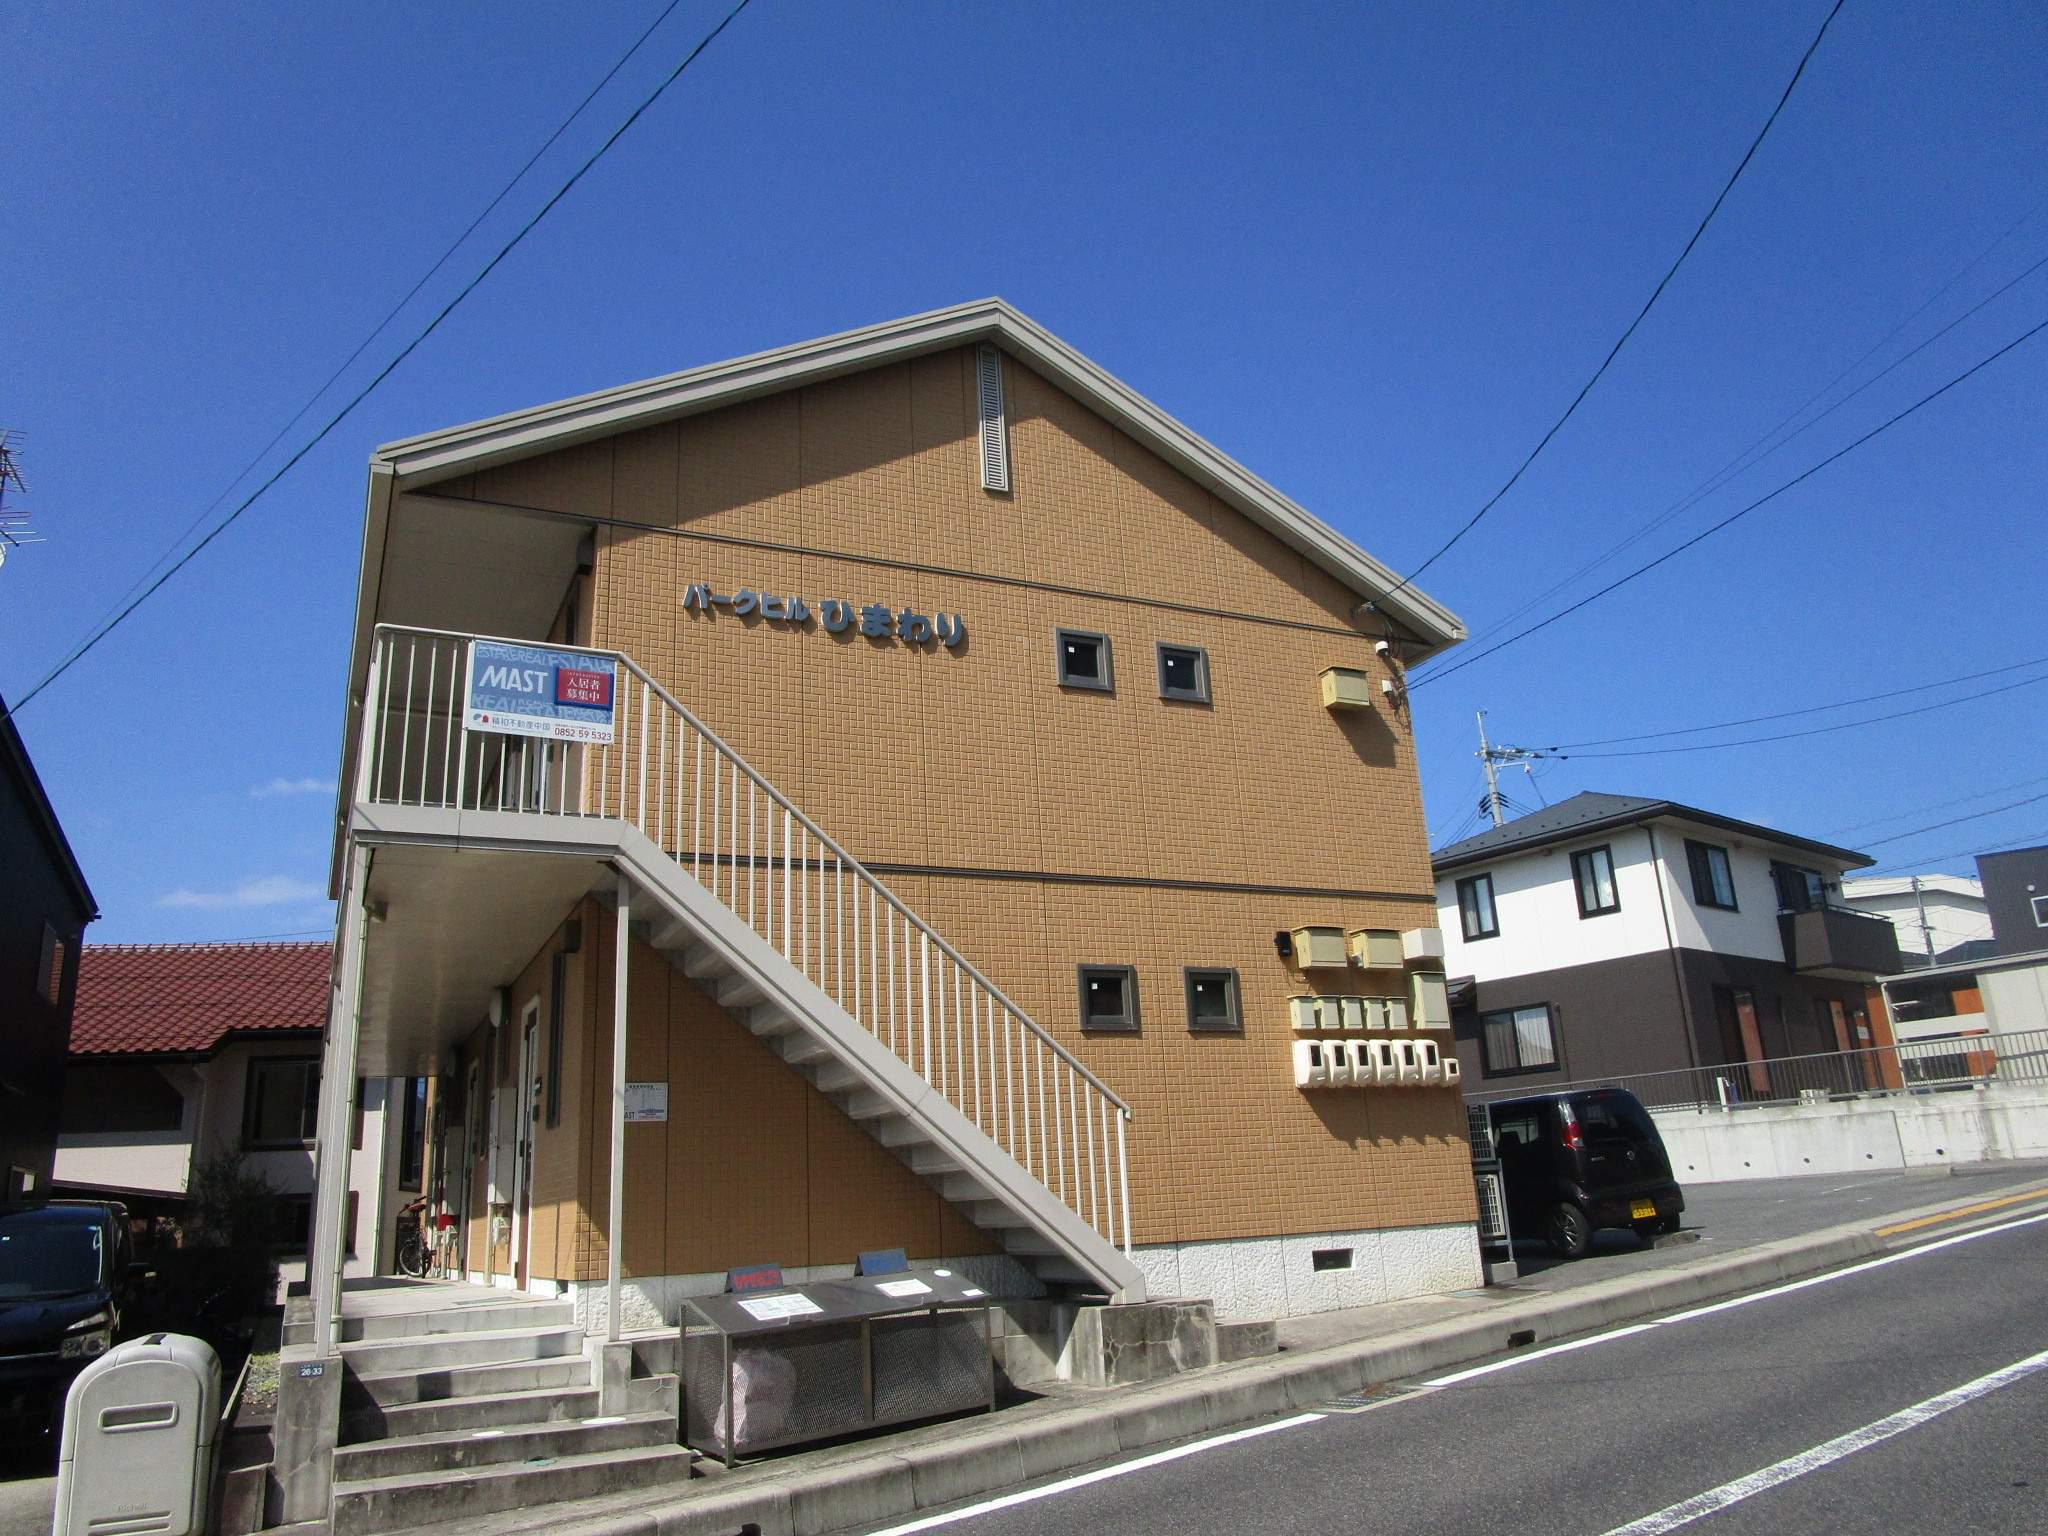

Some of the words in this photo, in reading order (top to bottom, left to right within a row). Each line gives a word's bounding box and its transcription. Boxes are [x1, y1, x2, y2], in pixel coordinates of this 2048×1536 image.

[683, 580, 810, 622] パークヒル
[818, 598, 963, 647] ひまわり
[479, 665, 549, 694] MAST
[567, 677, 600, 690] 入居者
[566, 688, 600, 702] 募集中
[492, 716, 550, 731] 積和不動産中国
[554, 727, 576, 737] 0852
[578, 730, 589, 738] 59
[591, 731, 612, 741] 5323
[624, 1111, 635, 1119] AST
